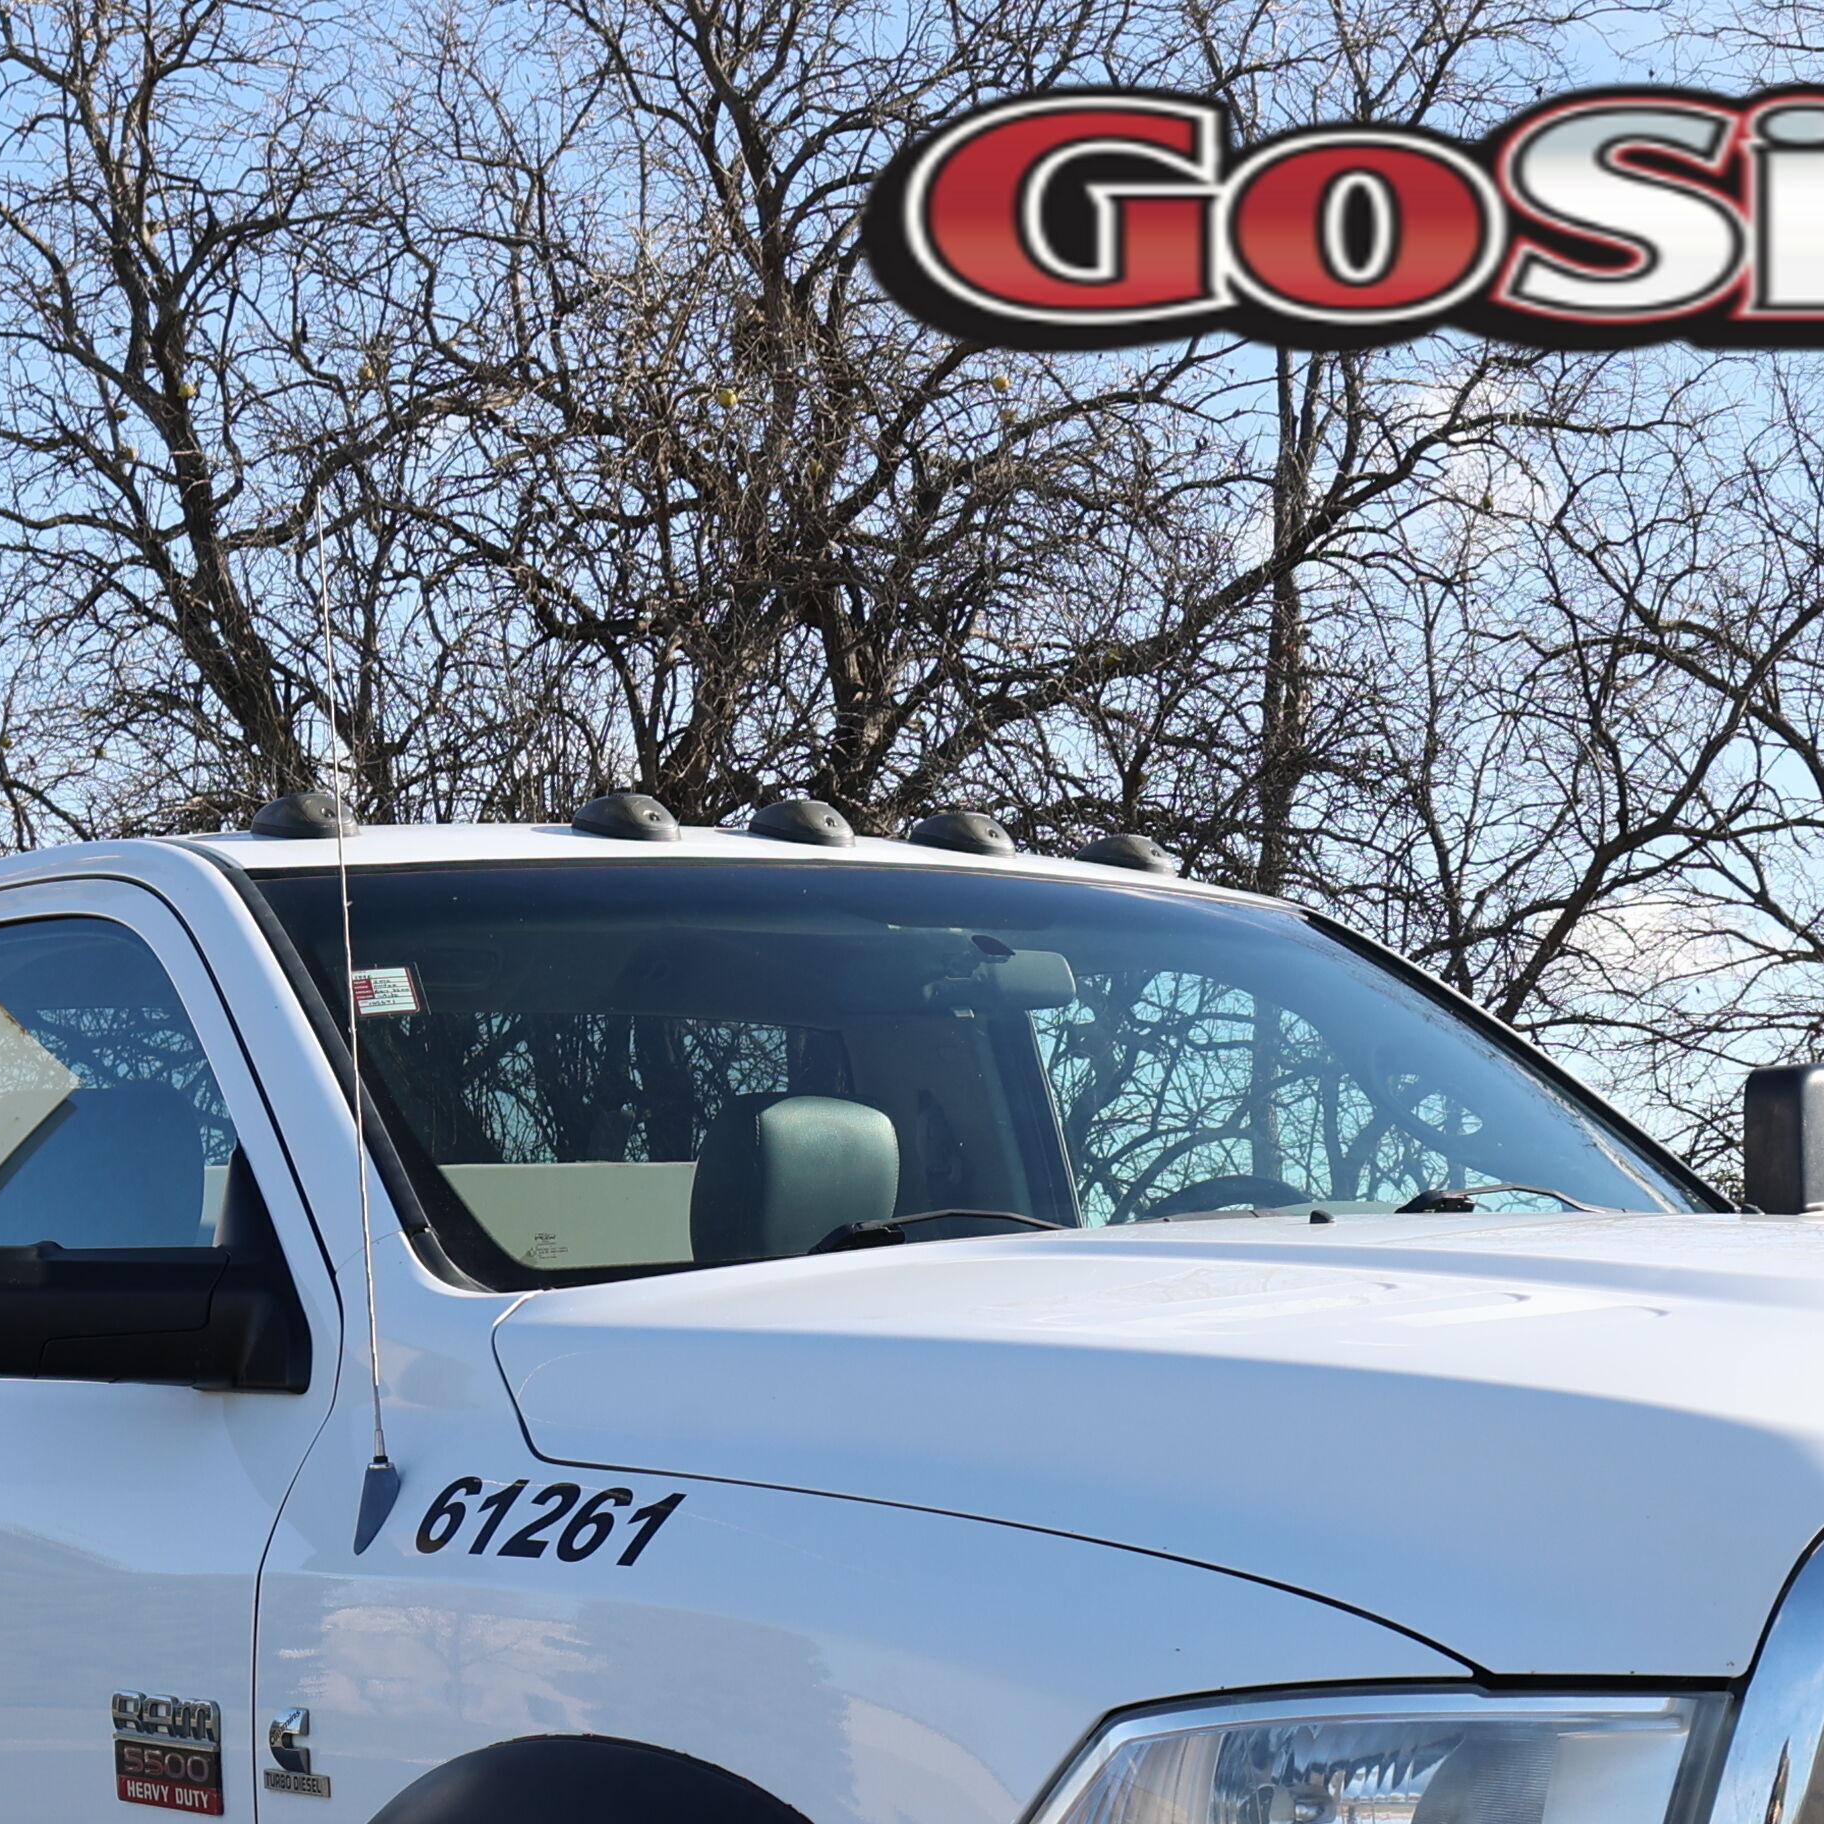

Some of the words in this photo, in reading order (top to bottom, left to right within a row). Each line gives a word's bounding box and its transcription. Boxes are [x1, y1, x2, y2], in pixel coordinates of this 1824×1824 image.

[416, 1476, 687, 1566] 61261
[123, 1744, 210, 1783] 5500
[126, 1779, 169, 1802] HEAVY
[175, 1787, 209, 1809] DUTY
[265, 1771, 291, 1789] TURBO
[293, 1776, 322, 1794] DIESEL
